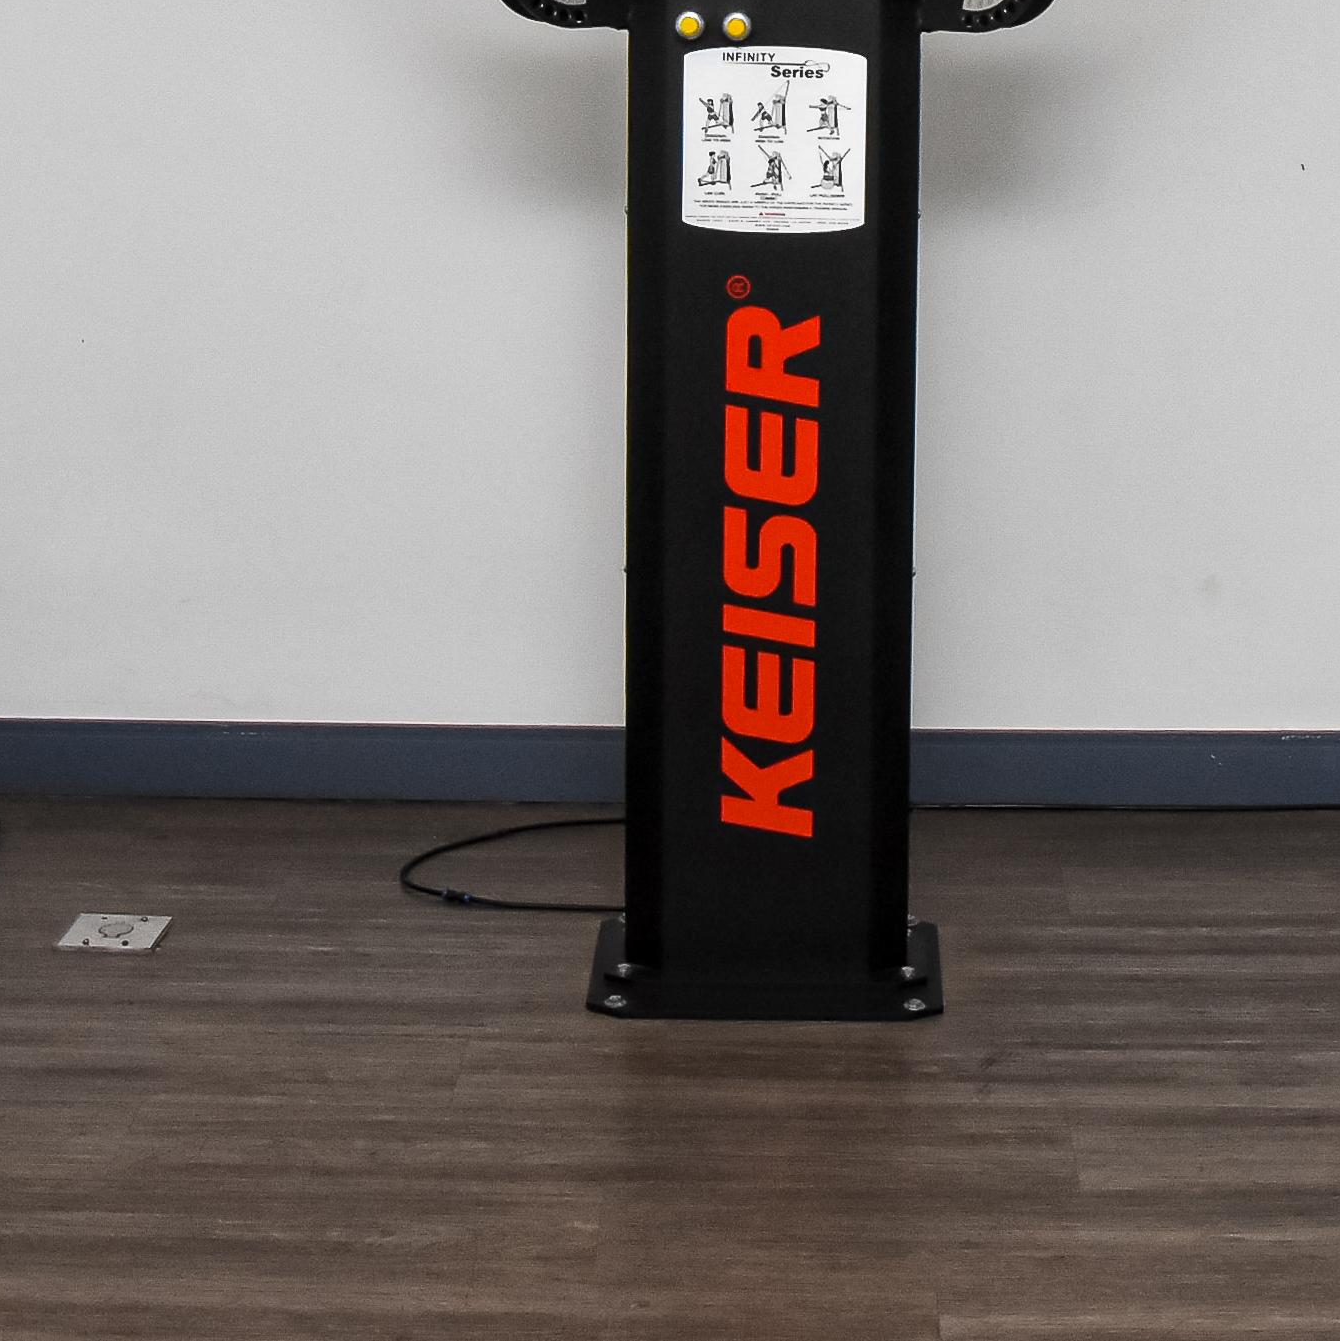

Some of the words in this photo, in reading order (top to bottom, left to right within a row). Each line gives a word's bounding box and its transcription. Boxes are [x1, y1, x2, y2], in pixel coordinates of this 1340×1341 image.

[722, 52, 776, 62] INFINITY
[770, 65, 824, 79] Series
[721, 305, 821, 838] KEISER
